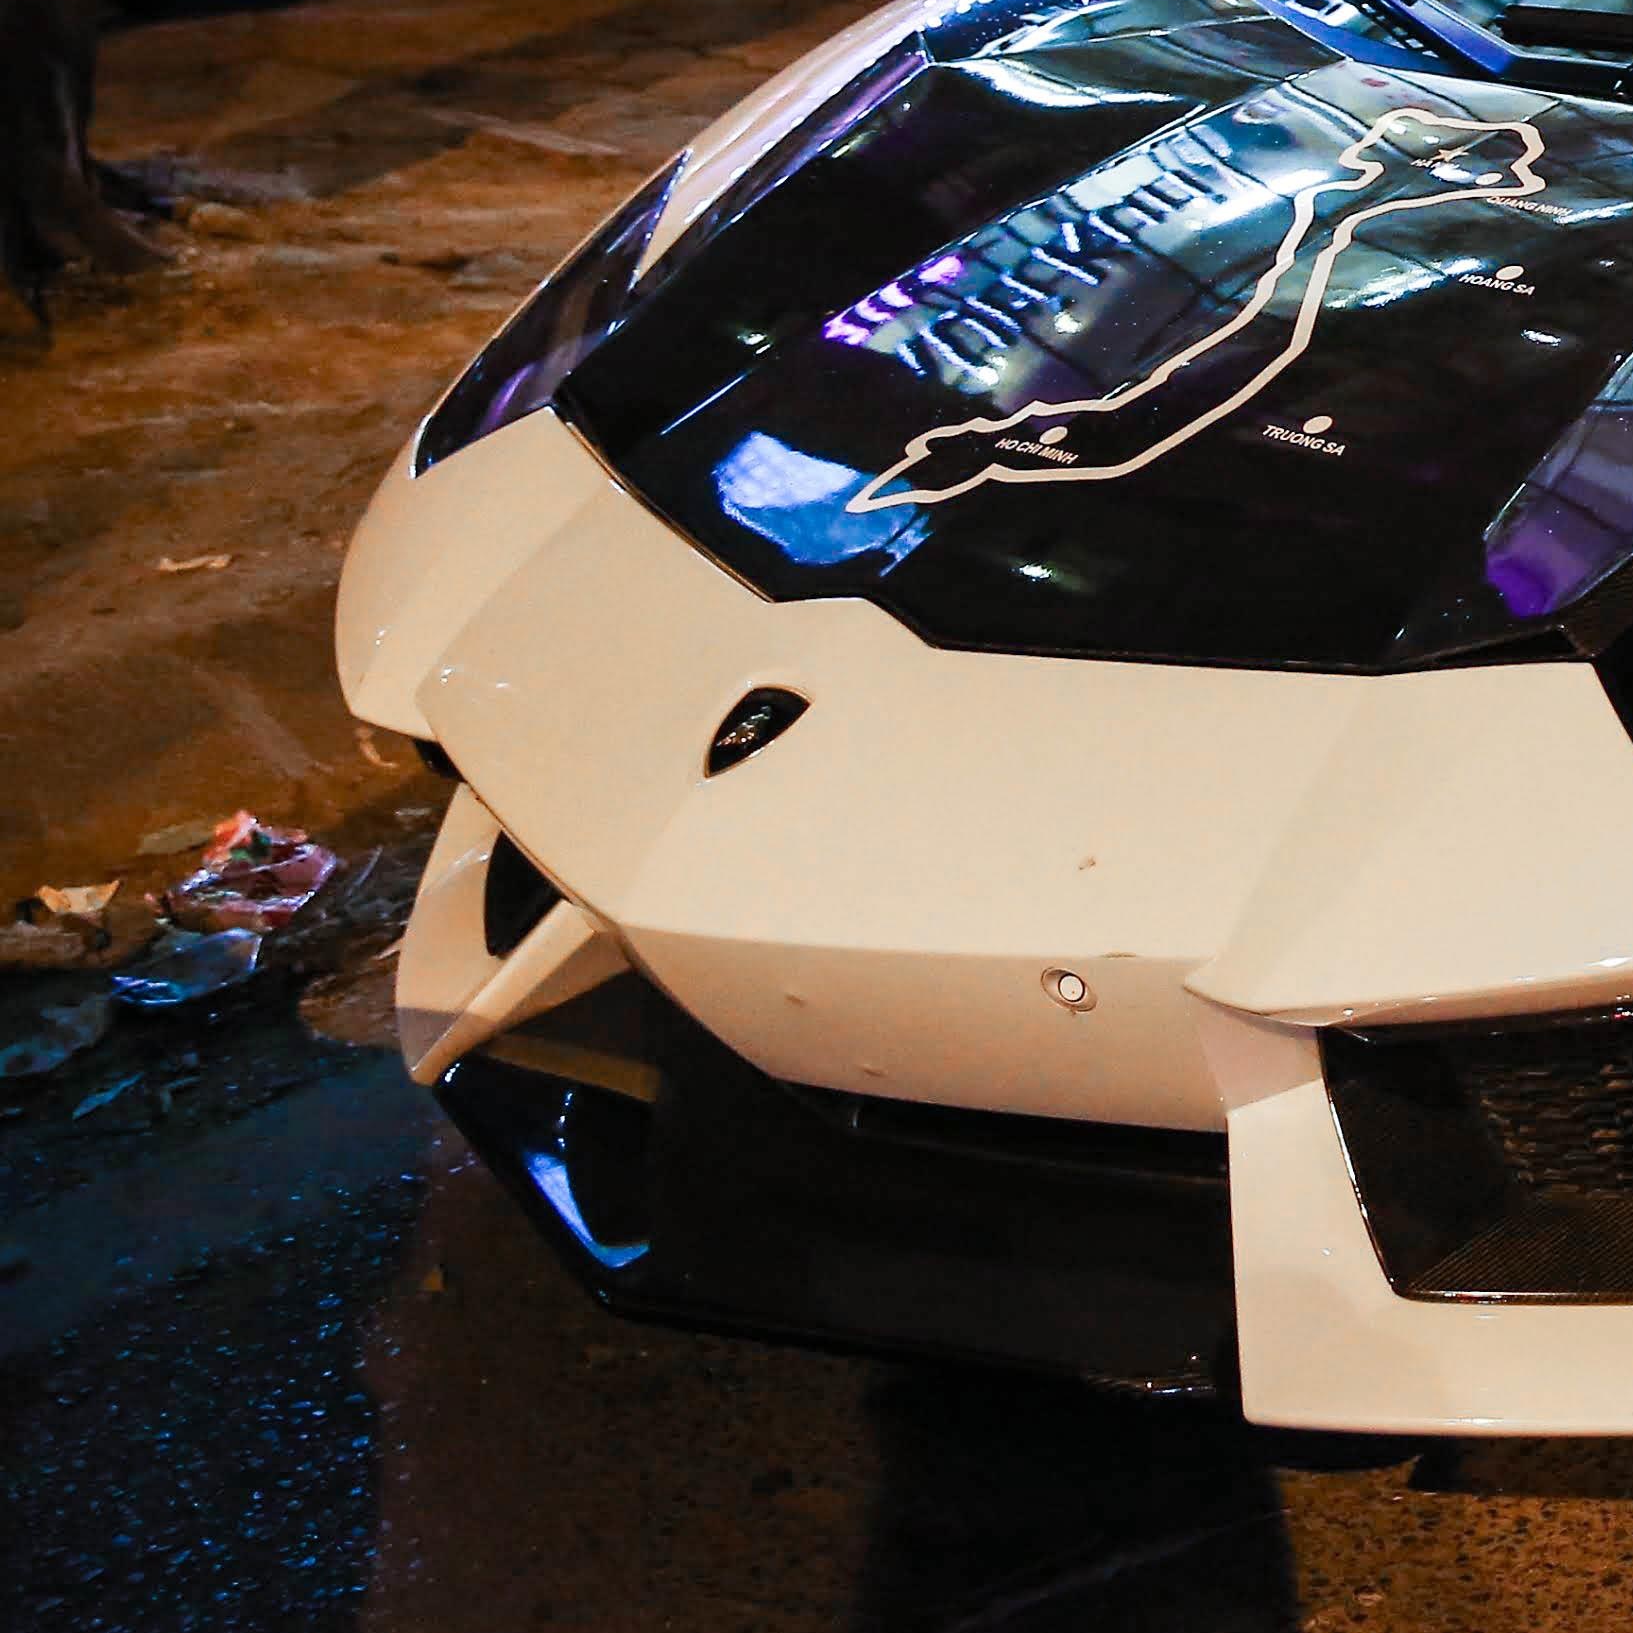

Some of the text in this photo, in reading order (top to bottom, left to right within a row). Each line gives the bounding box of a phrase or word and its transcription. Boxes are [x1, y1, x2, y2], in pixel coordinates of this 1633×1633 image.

[1486, 196, 1538, 211] QUANG
[1458, 273, 1536, 296] HOANG SA
[994, 437, 1079, 465] HO CHI MINH
[1262, 424, 1346, 456] TRUONG SA
